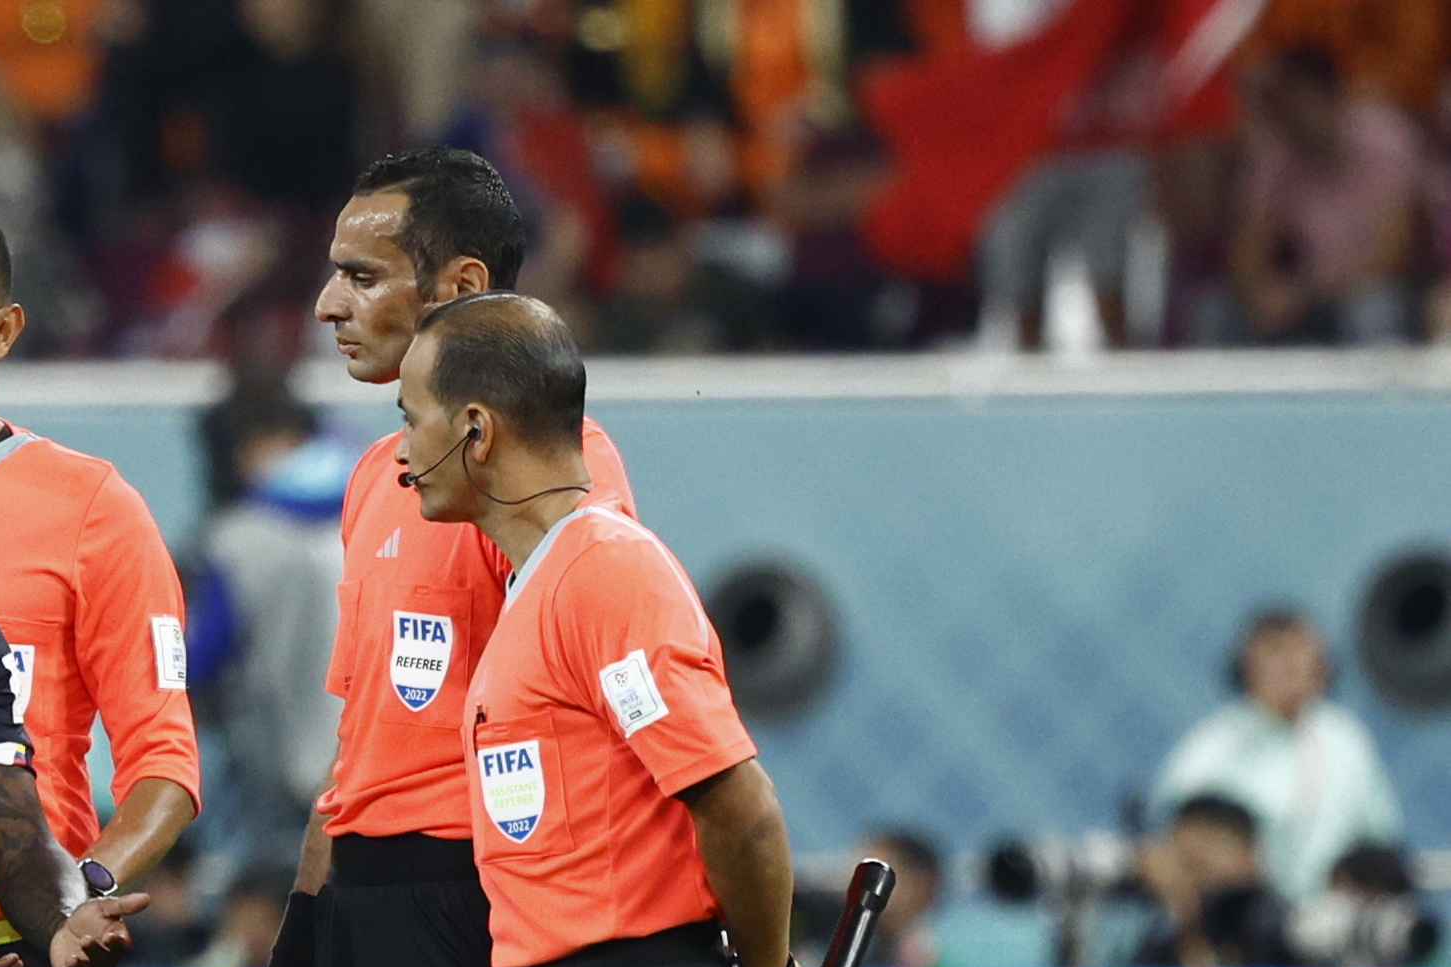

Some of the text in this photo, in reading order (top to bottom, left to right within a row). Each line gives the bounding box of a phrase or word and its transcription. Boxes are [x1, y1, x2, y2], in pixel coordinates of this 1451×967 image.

[399, 617, 446, 644] FIFA
[395, 655, 443, 672] REFEREE
[404, 688, 428, 702] 2022
[483, 748, 534, 777] FIFA
[506, 820, 530, 834] 2022
